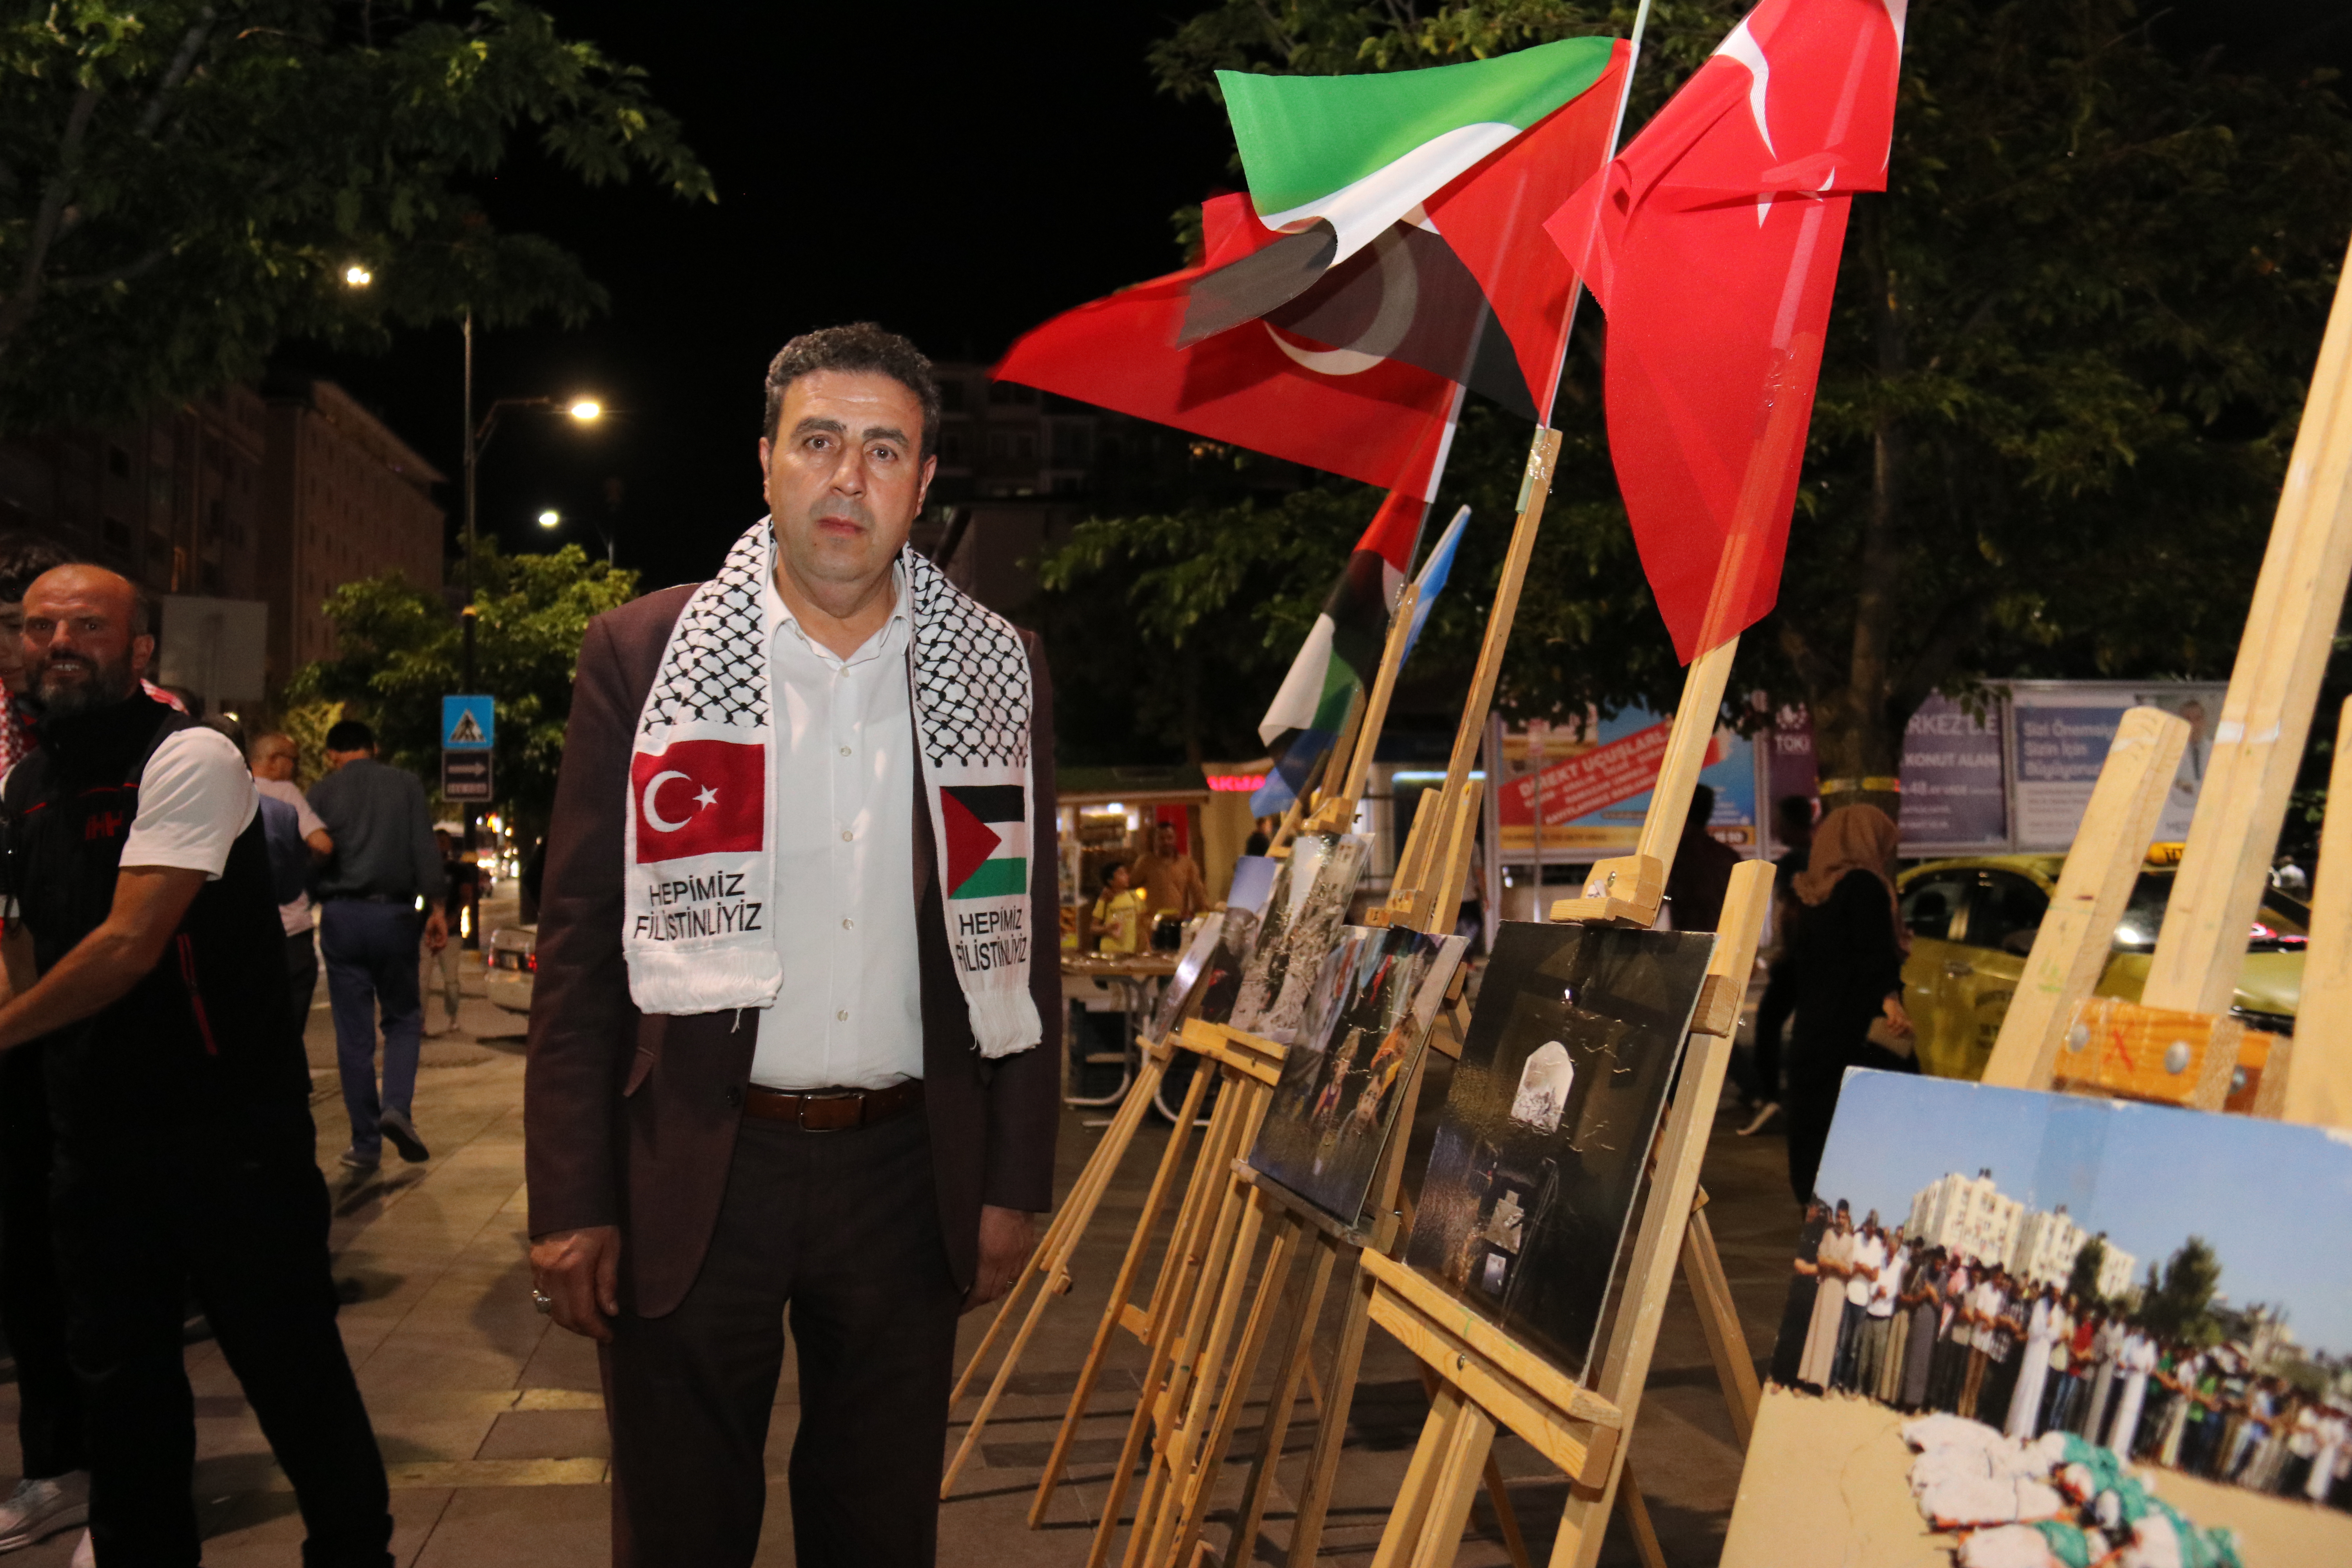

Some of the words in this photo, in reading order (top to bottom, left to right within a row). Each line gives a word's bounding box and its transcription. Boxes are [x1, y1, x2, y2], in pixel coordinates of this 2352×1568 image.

[650, 871, 745, 906] HEPİMİZ
[633, 899, 762, 940] FİLİSTİNLİYİZ
[959, 905, 1022, 936] HEPİMİZ
[956, 933, 1027, 972] FİLİSTİNLİYİZ
